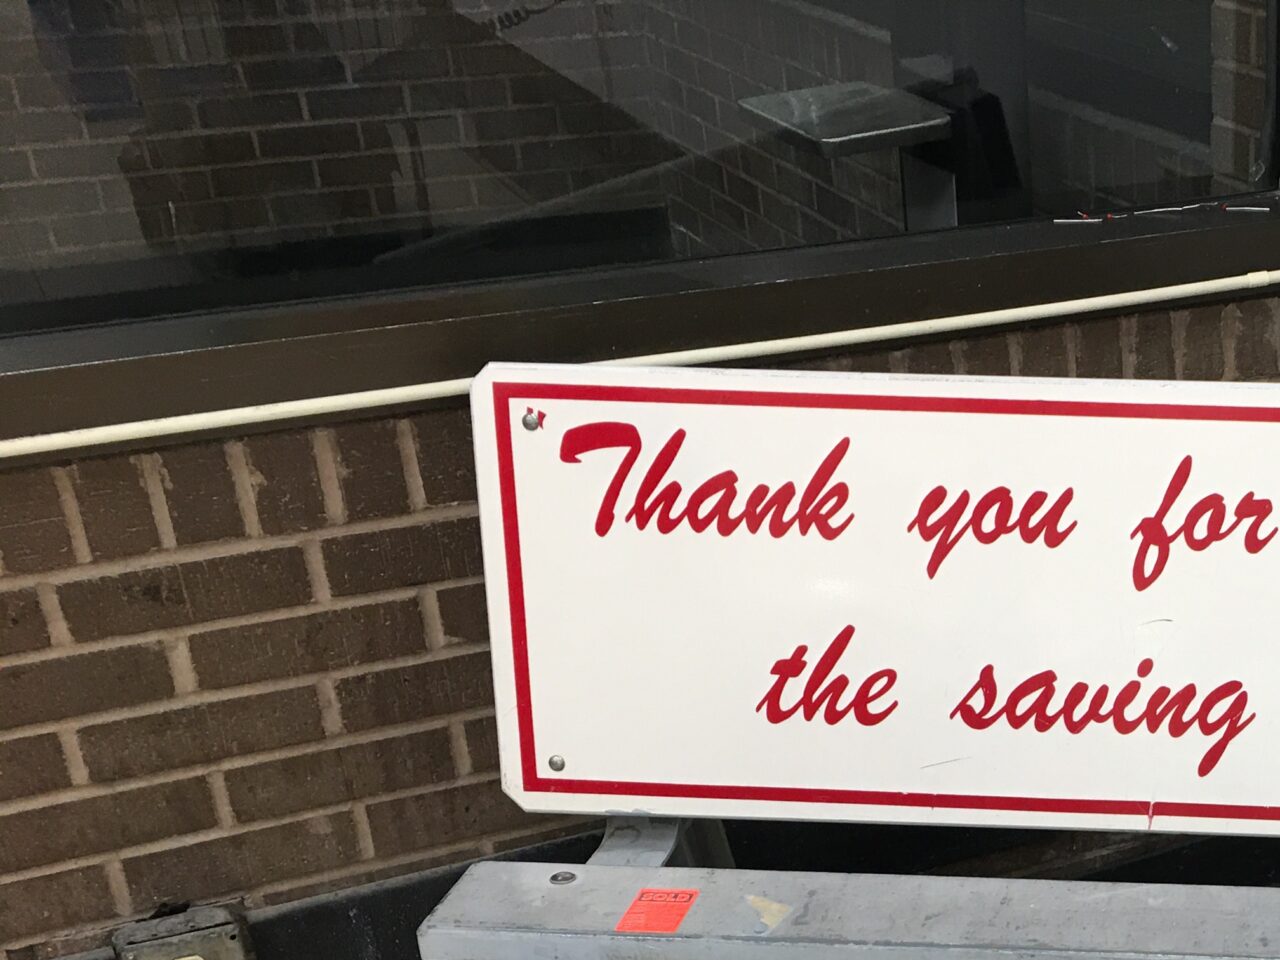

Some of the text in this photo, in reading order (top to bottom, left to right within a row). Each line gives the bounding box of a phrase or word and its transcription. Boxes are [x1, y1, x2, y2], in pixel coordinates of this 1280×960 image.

[907, 485, 1077, 579] you
[1130, 455, 1279, 592] for
[755, 624, 898, 727] the
[949, 658, 1256, 778] saving
[640, 892, 693, 902] SOLD
